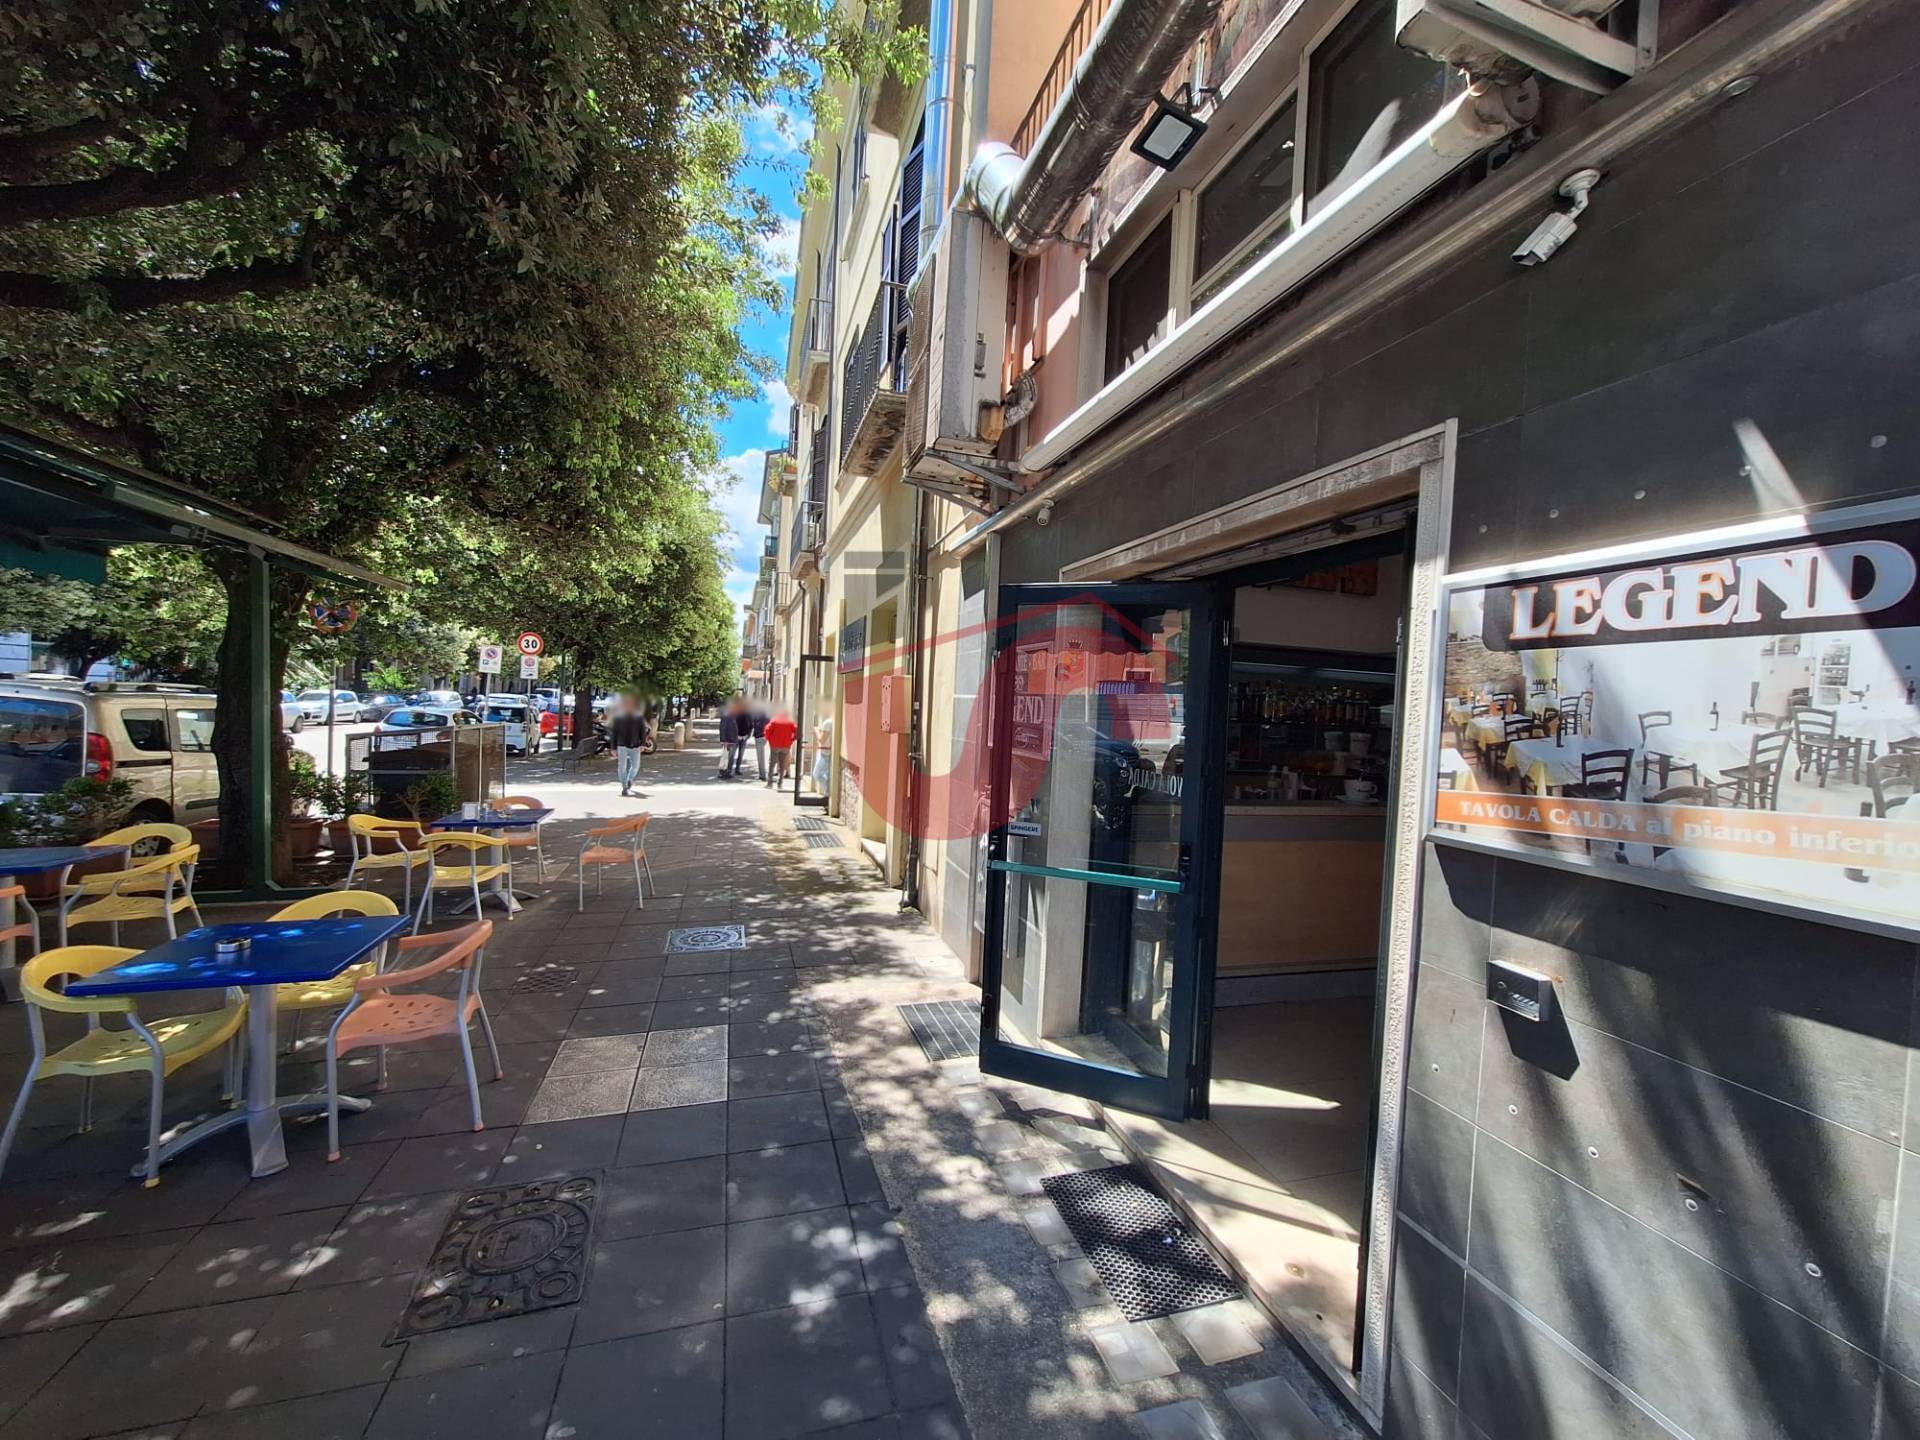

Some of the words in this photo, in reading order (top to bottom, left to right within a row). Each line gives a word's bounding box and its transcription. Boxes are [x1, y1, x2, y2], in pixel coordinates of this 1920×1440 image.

[1509, 539, 1918, 640] LEGEND
[523, 639, 538, 649] 30
[1460, 801, 1541, 823] TAVOLA
[1549, 808, 1637, 832] CALDA
[1645, 817, 1672, 836] al
[1684, 819, 1777, 845] piano
